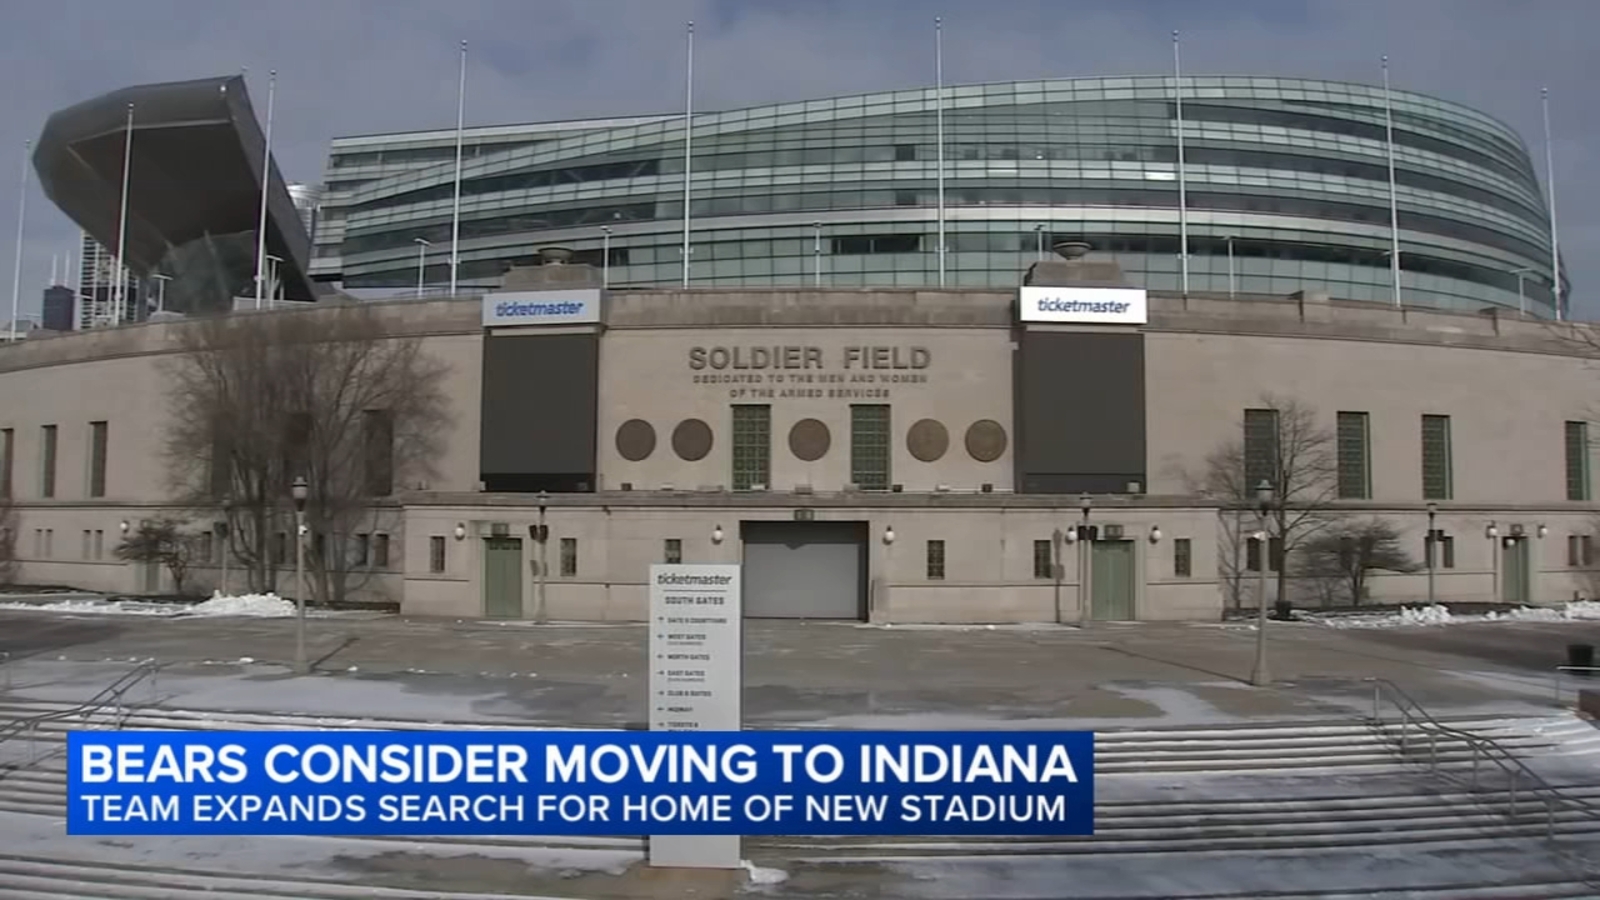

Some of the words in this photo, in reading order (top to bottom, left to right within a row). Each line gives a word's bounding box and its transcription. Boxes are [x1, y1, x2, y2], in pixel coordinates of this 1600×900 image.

[496, 302, 584, 317] ticketmaster
[1037, 297, 1131, 313] ticketmaster
[689, 346, 823, 370] SOLDIER
[843, 346, 932, 370] FIELD
[693, 374, 762, 384] DEDICATED
[768, 374, 784, 384] TO
[790, 374, 813, 384] THE
[818, 374, 845, 384] MEN
[851, 374, 875, 384] AND
[880, 374, 927, 384] WOMEN
[730, 389, 745, 398] OF
[751, 389, 774, 398] THE
[779, 389, 823, 398] ARMED
[828, 389, 890, 398] SERVICES
[657, 573, 732, 585] ticketmaster
[665, 597, 694, 605] SOUTH
[696, 597, 725, 605] GATES
